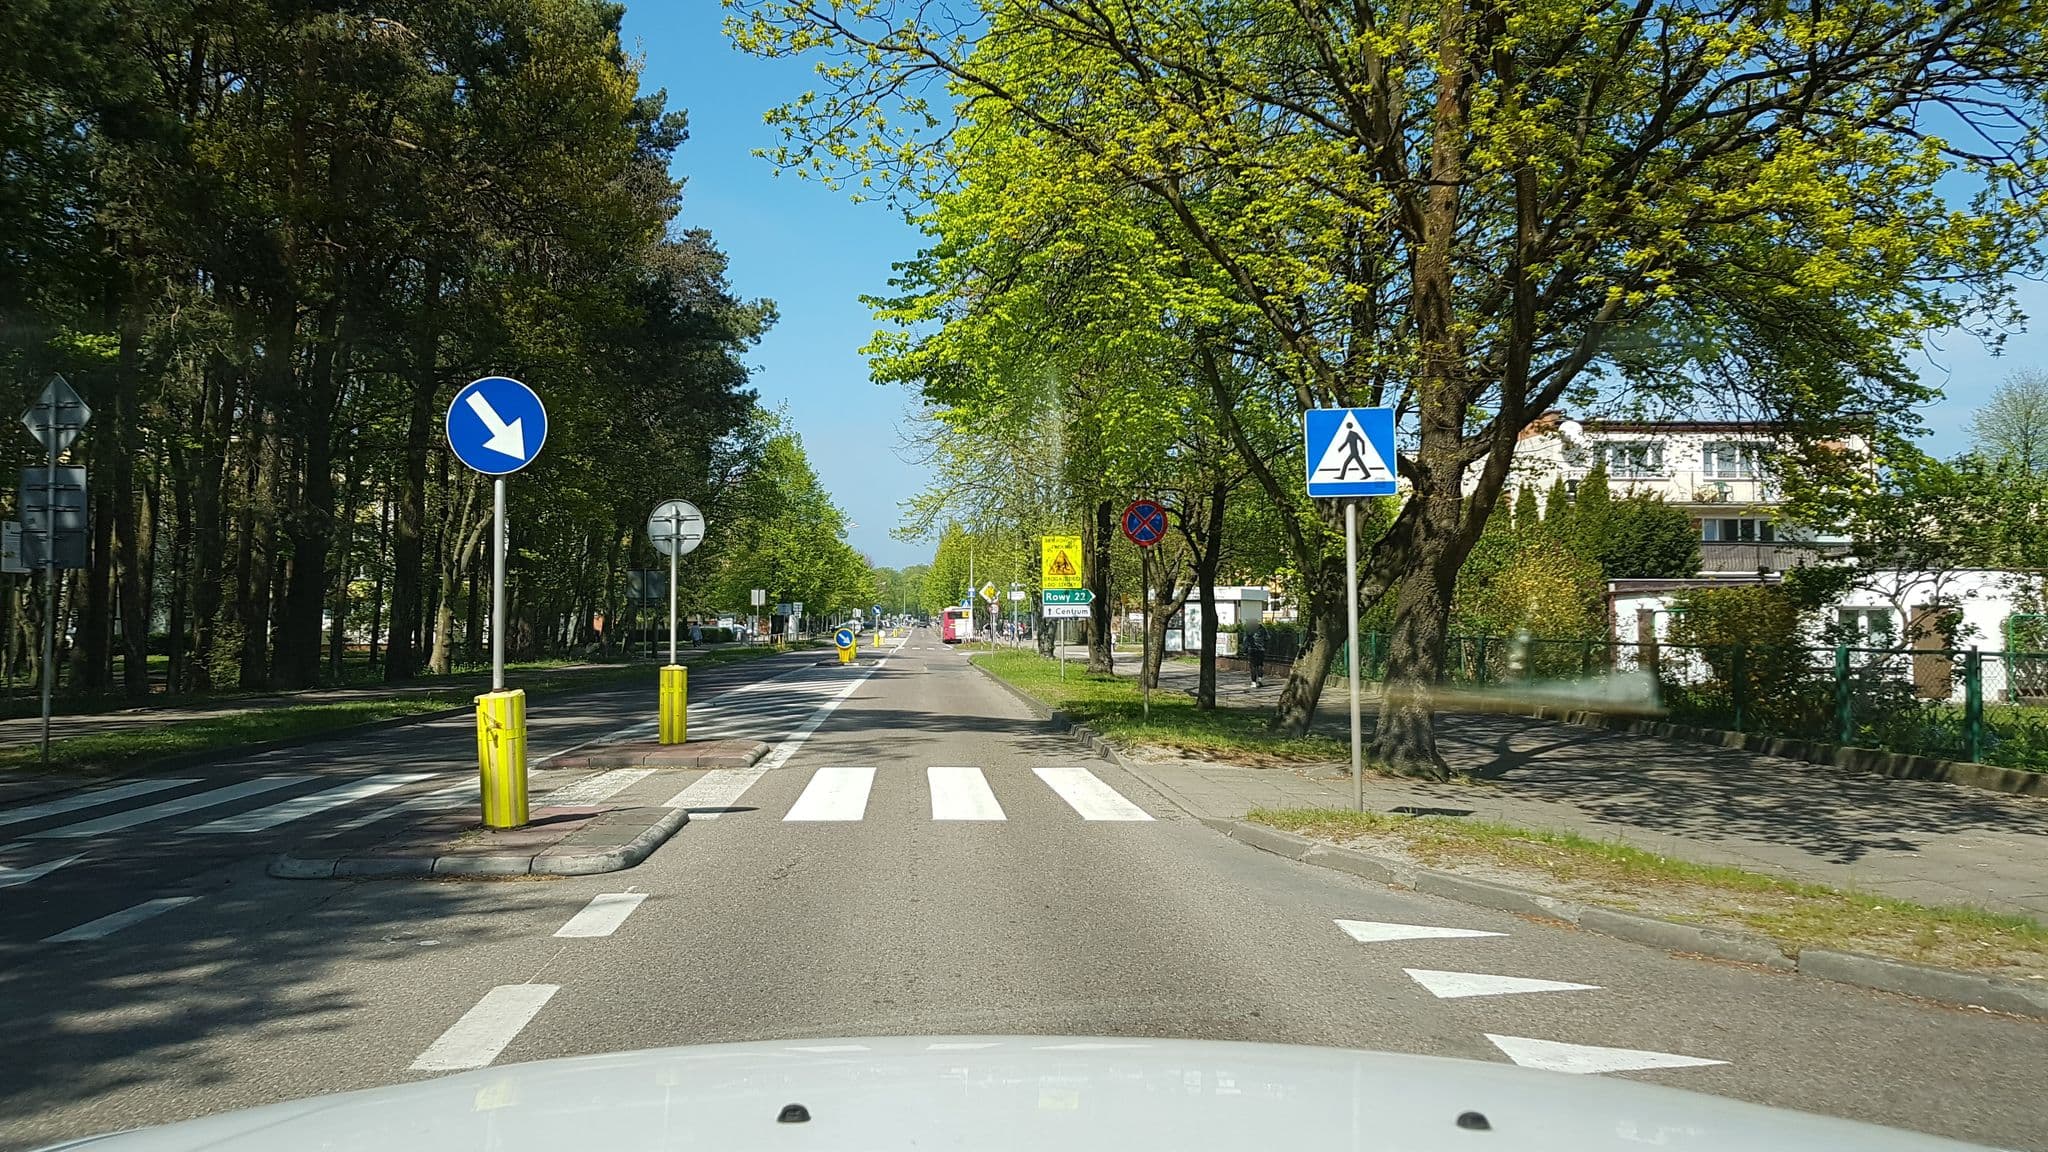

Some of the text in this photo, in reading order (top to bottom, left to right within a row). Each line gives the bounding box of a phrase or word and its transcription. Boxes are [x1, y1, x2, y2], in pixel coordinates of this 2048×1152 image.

[1045, 592, 1086, 603] Rowy 22
[1055, 607, 1089, 615] Centrum
